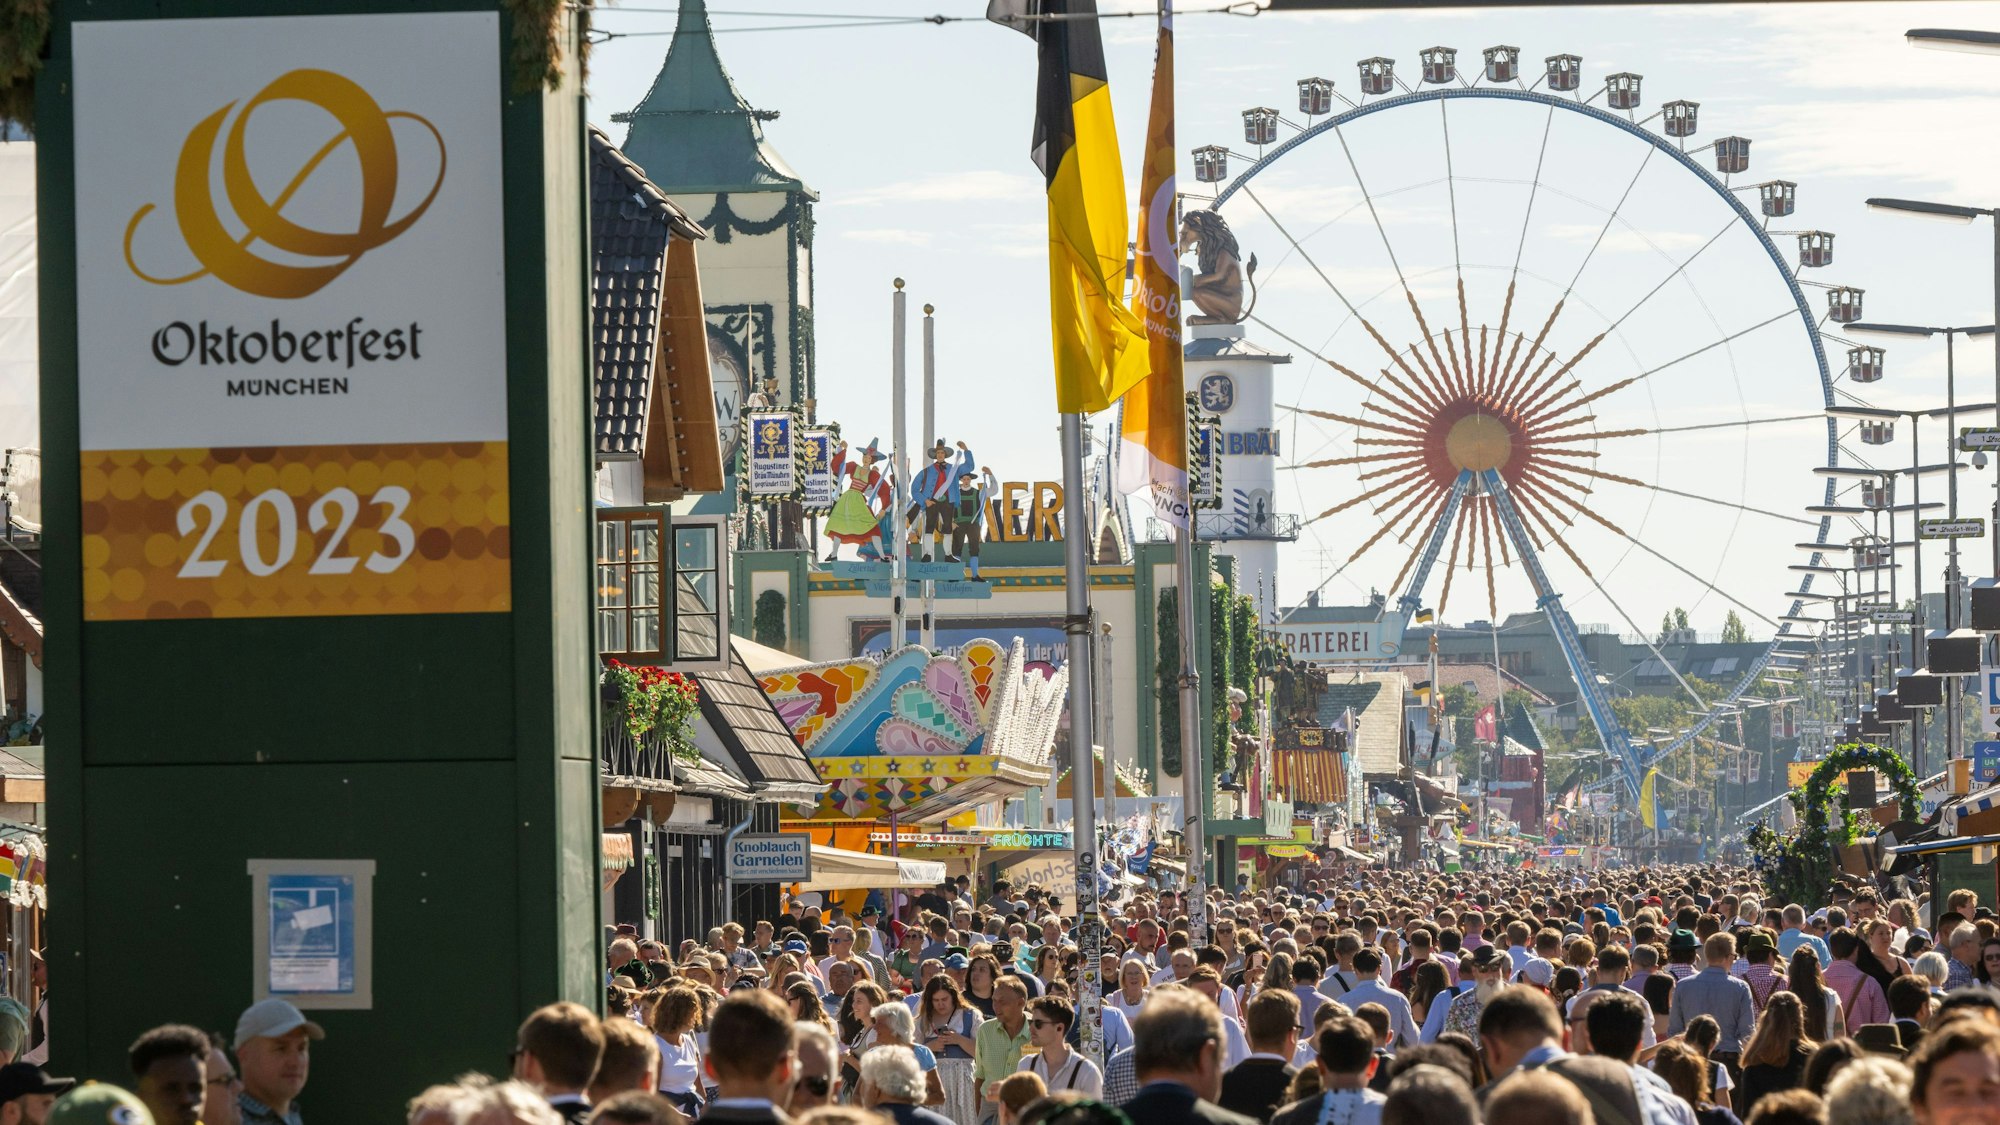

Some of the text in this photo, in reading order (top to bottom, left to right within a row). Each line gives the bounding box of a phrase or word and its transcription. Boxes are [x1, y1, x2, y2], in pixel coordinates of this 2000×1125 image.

[152, 317, 422, 369] Oktoberfest
[226, 377, 349, 397] MÜNCHEN
[719, 430, 728, 441] 8
[176, 485, 416, 578] 2023
[918, 563, 949, 574] Zillertal
[1034, 643, 1053, 661] der
[735, 841, 801, 853] Knoblauch
[993, 832, 1063, 848] FRÜCHTE
[733, 853, 803, 867] Garnelen
